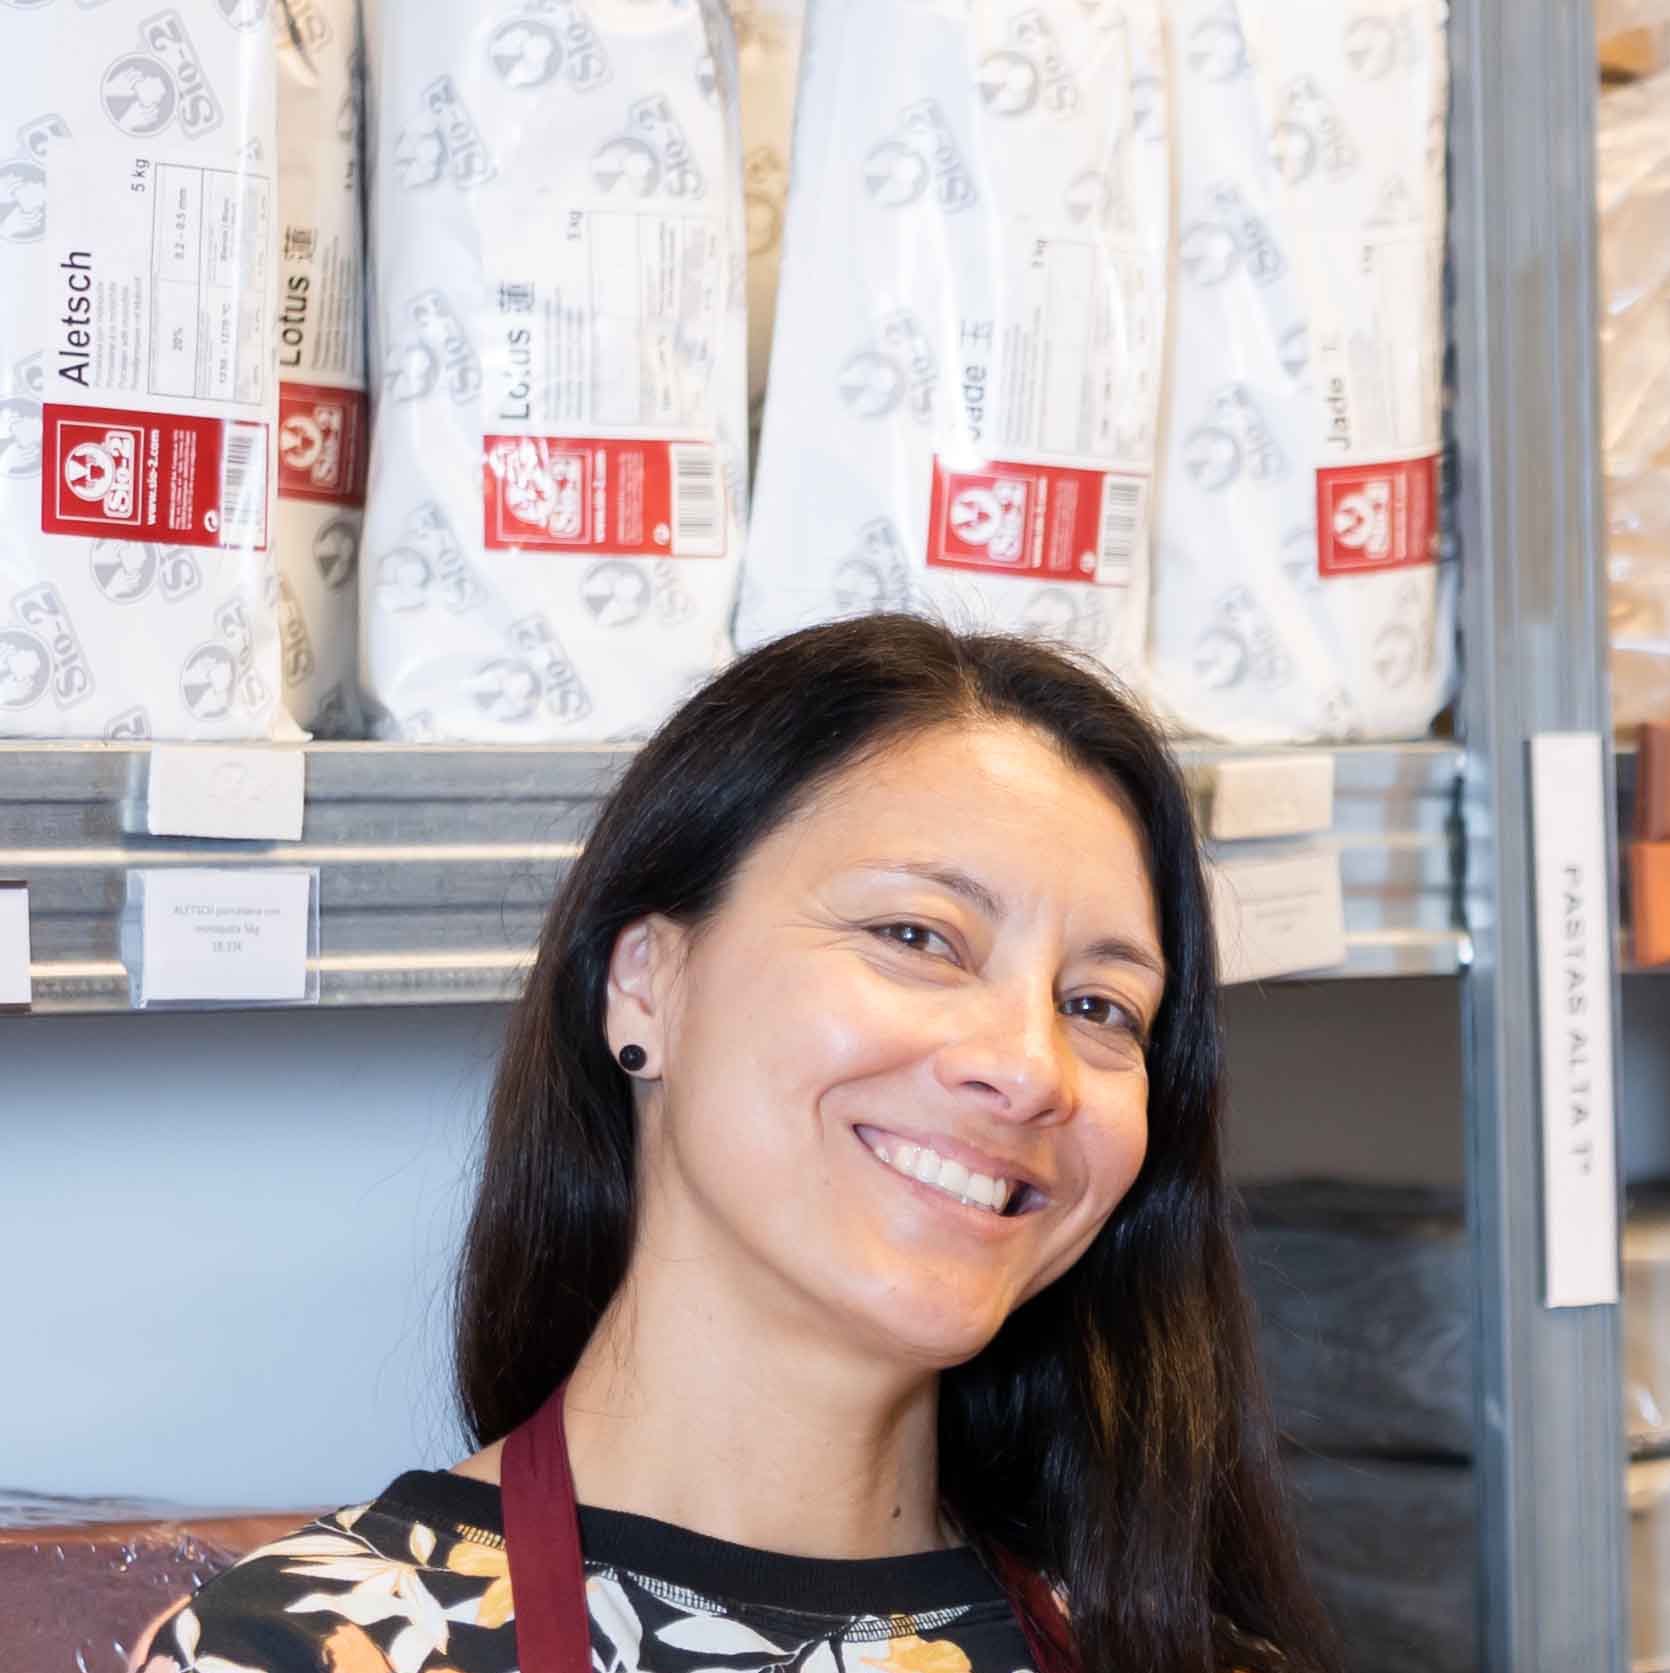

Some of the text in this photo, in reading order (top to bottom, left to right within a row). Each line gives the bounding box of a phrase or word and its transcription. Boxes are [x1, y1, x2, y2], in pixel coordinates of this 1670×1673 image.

[131, 158, 150, 193] 5 kg
[58, 250, 92, 388] Aletsch
[279, 275, 311, 368] Lotus
[106, 437, 132, 512] Sio-2
[1562, 862, 1591, 1016] PASTAS
[1568, 1028, 1592, 1127] ALTA
